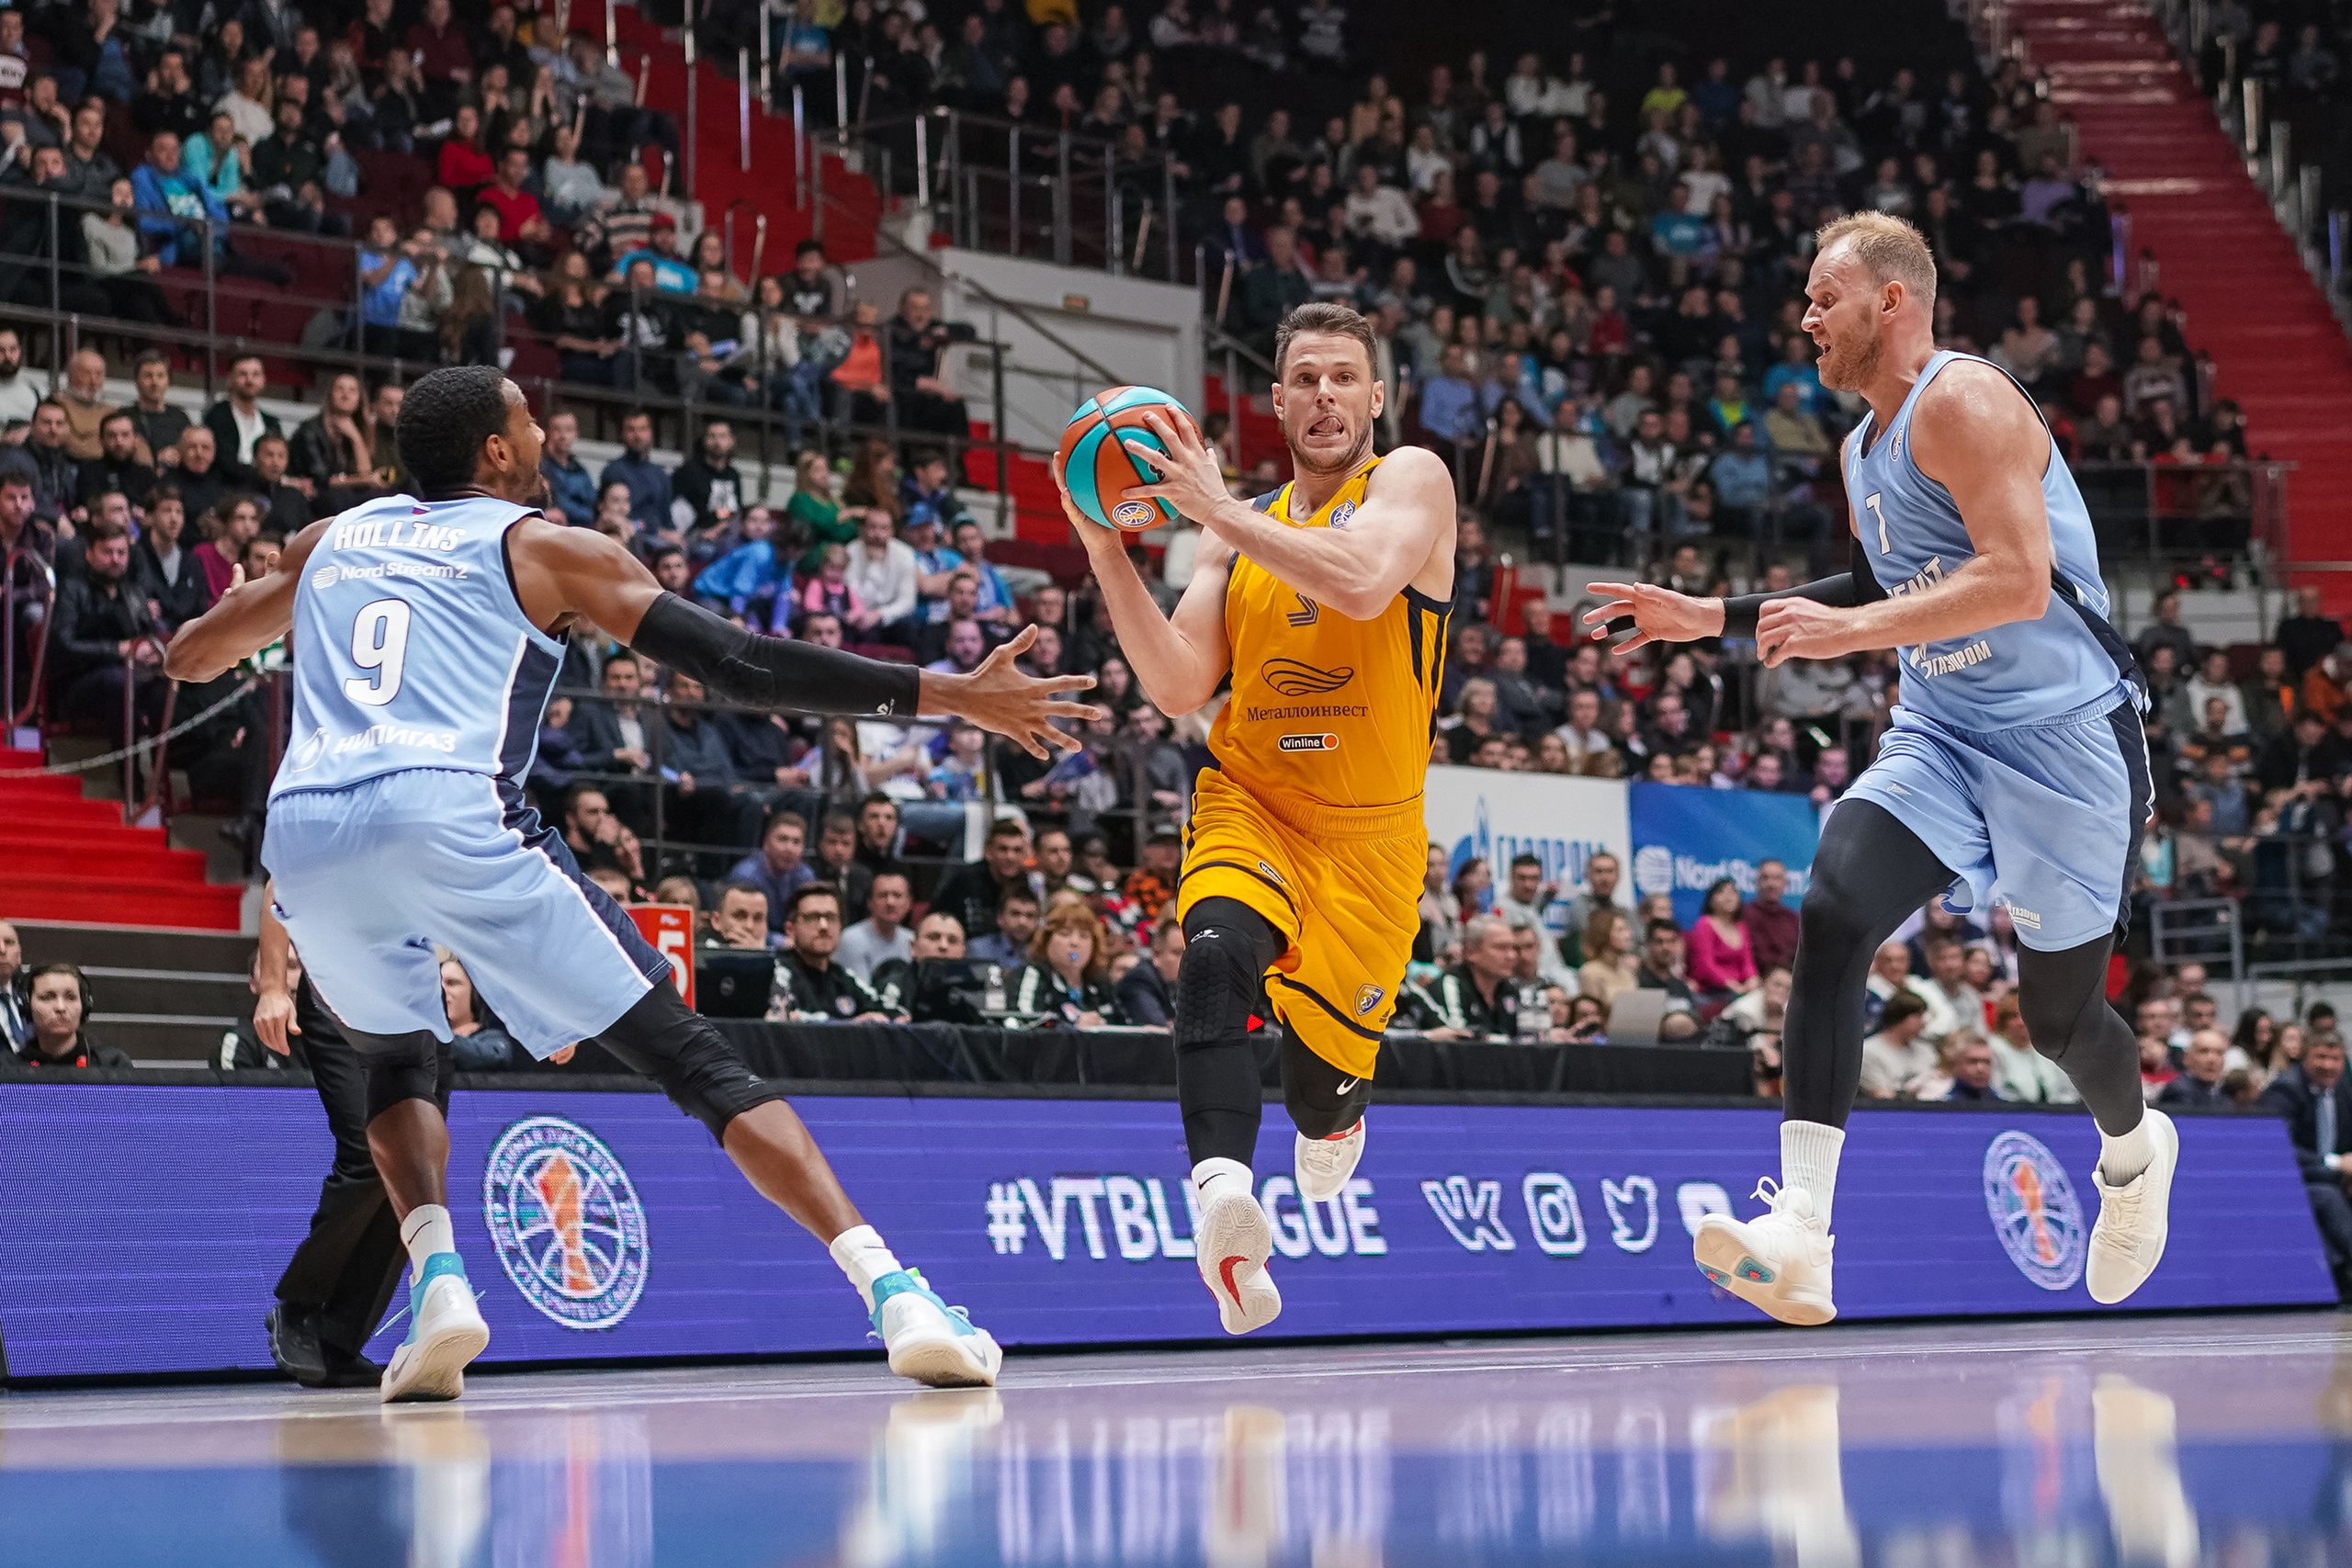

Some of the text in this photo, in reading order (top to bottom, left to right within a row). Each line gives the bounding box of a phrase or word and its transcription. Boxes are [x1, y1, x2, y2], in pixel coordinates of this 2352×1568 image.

[333, 521, 467, 552] HOLLINS
[1865, 492, 1891, 556] 7
[340, 561, 469, 581] Nord Stream 2
[345, 598, 412, 706] 9
[1247, 705, 1368, 722] Металлоинвест
[334, 724, 458, 754] НИПИГАЗ
[1282, 738, 1320, 749] Winline
[985, 1175, 1389, 1261] #VTBLGUE
